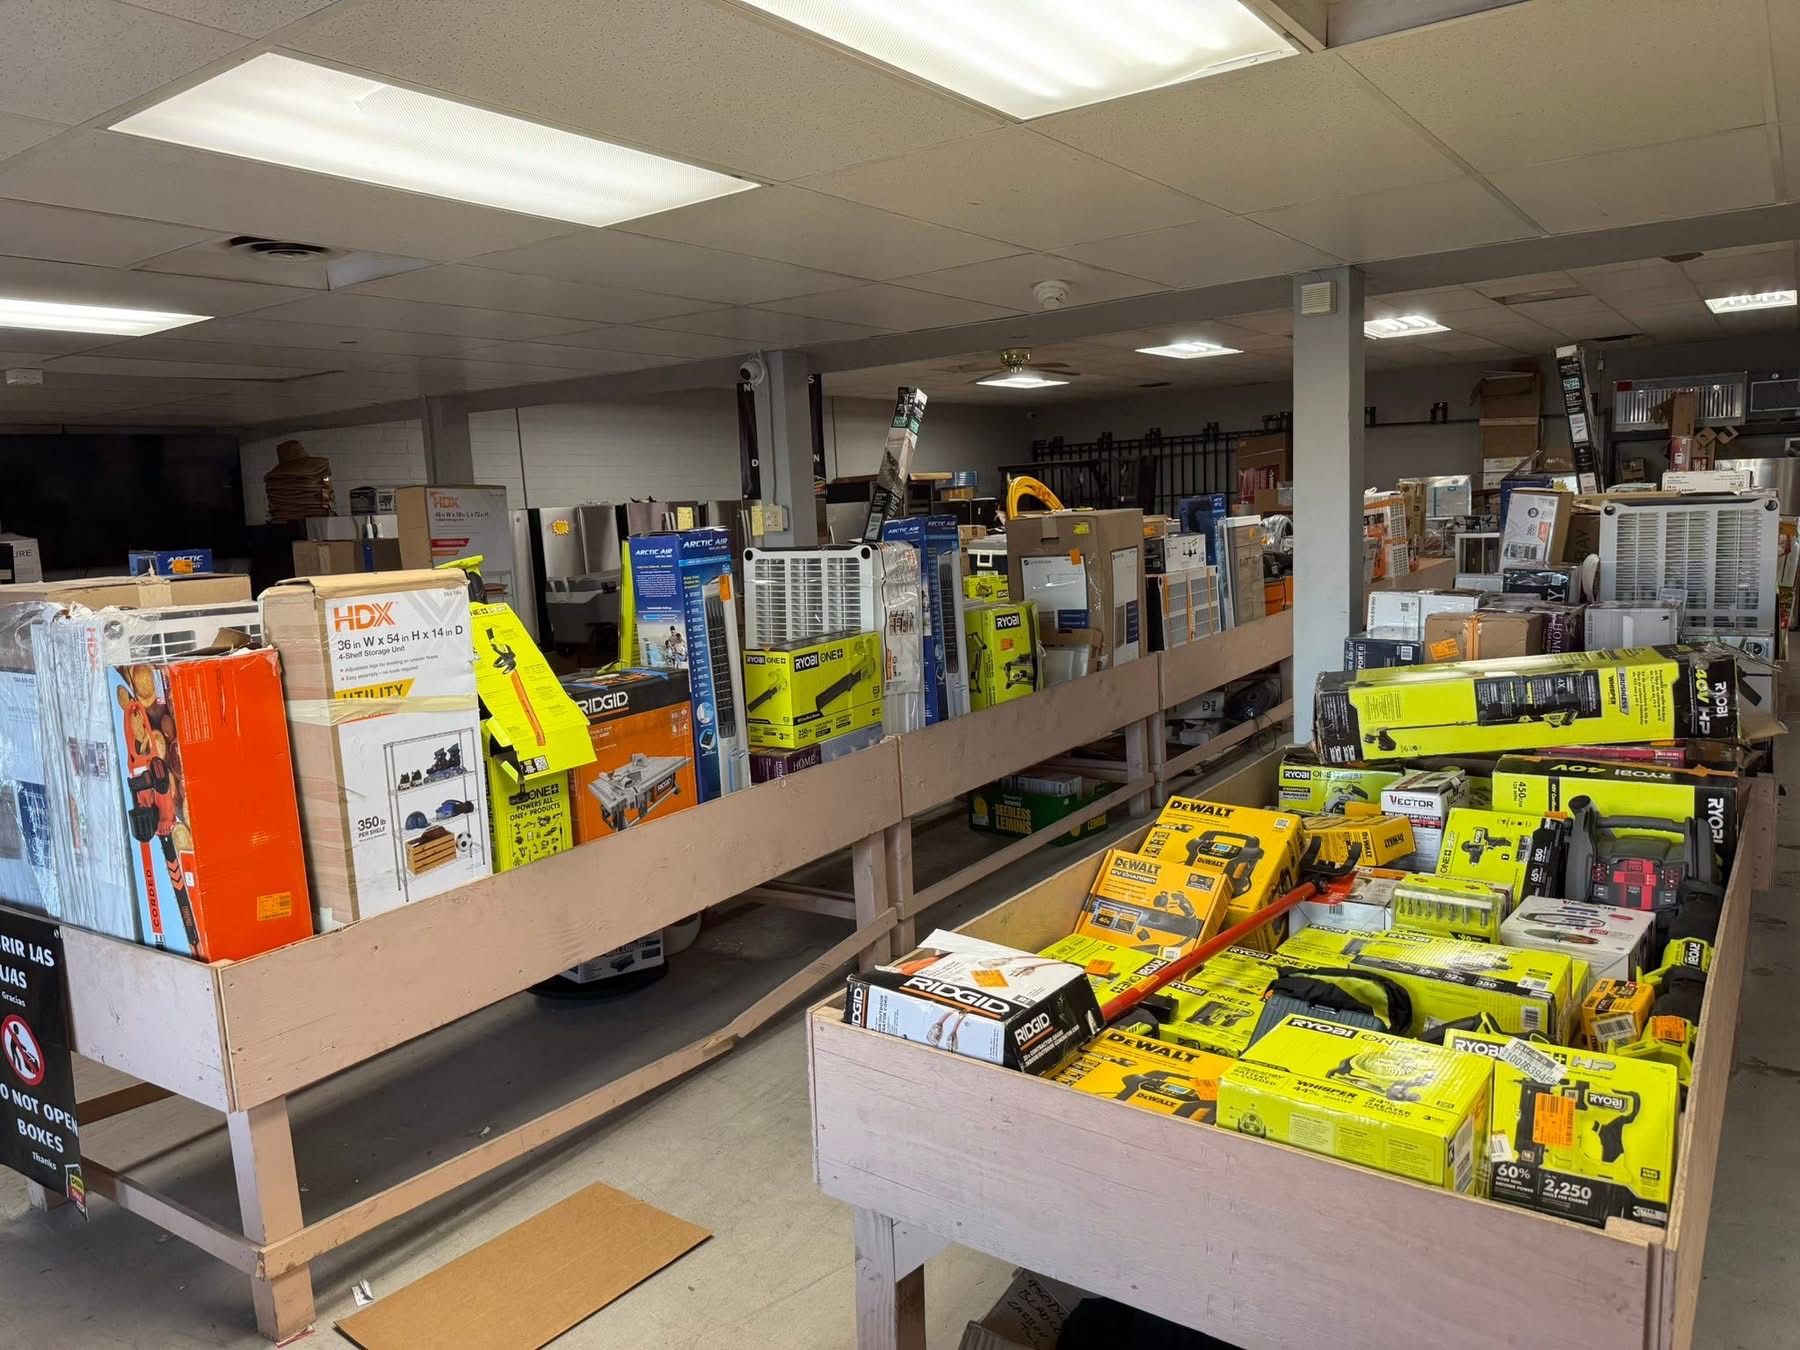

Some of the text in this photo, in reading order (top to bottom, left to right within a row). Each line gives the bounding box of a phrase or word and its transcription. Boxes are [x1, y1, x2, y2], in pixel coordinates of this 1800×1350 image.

[683, 539, 713, 549] ARCTIC
[332, 601, 395, 632] HDX
[997, 613, 1020, 628] RYOBI
[337, 639, 351, 651] 36
[353, 640, 361, 649] in
[363, 637, 375, 647] W
[387, 633, 400, 644] 54
[402, 634, 409, 642] in
[411, 631, 420, 641] H
[432, 627, 444, 638] 14
[445, 629, 453, 637] in
[455, 625, 464, 635] D
[339, 645, 405, 660] 4-Shelf Storage Unit
[746, 656, 765, 664] RYOBI
[794, 652, 819, 671] RYOBI
[1618, 671, 1628, 710] BRUSHLESS
[1695, 667, 1709, 704] 40V
[577, 691, 629, 714] RIDGID
[1714, 681, 1728, 718] RYOBI
[793, 754, 816, 771] HOME
[1285, 770, 1310, 780] RYOBI
[1550, 764, 1672, 780] RYOBI 40V
[1517, 781, 1527, 798] 450
[516, 798, 553, 812] POWERS ALL
[530, 803, 560, 814] PRODUCTS
[1390, 794, 1434, 808] VECTOR
[994, 804, 1032, 822] SEEDLESS
[357, 816, 379, 832] 350
[358, 826, 386, 838] PER SHELF
[996, 815, 1033, 835] LEMONS
[1535, 848, 1544, 862] 850
[146, 869, 160, 928] CORDED
[1309, 924, 1347, 934] RYOBI
[1387, 932, 1432, 944] RYOBI
[0, 934, 56, 968] RIR LAS
[1230, 947, 1270, 960] RYOBI
[1687, 943, 1701, 964] RYOBI
[1169, 982, 1205, 995] RYOBI
[1476, 980, 1497, 988] 350
[1, 990, 26, 1007] Gracias
[903, 976, 1011, 1014] RIDGID
[1015, 1012, 1050, 1046] RIDGID
[1291, 1018, 1356, 1038] RYOBI
[1031, 1038, 1051, 1057] CONTRACTOR
[1571, 1055, 1617, 1072] HP
[1292, 1086, 1319, 1097] 44%
[1296, 1079, 1358, 1099] WHISPER
[1365, 1102, 1412, 1116] GREATER
[1590, 1092, 1624, 1109] RYOBI
[12, 1089, 79, 1137] NOT OPEN
[16, 1118, 65, 1154] BOXES
[32, 1151, 57, 1171] Thanks
[1497, 1163, 1531, 1180] 60%
[1544, 1178, 1593, 1201] 2,250
[1632, 1205, 1642, 1217] 3
